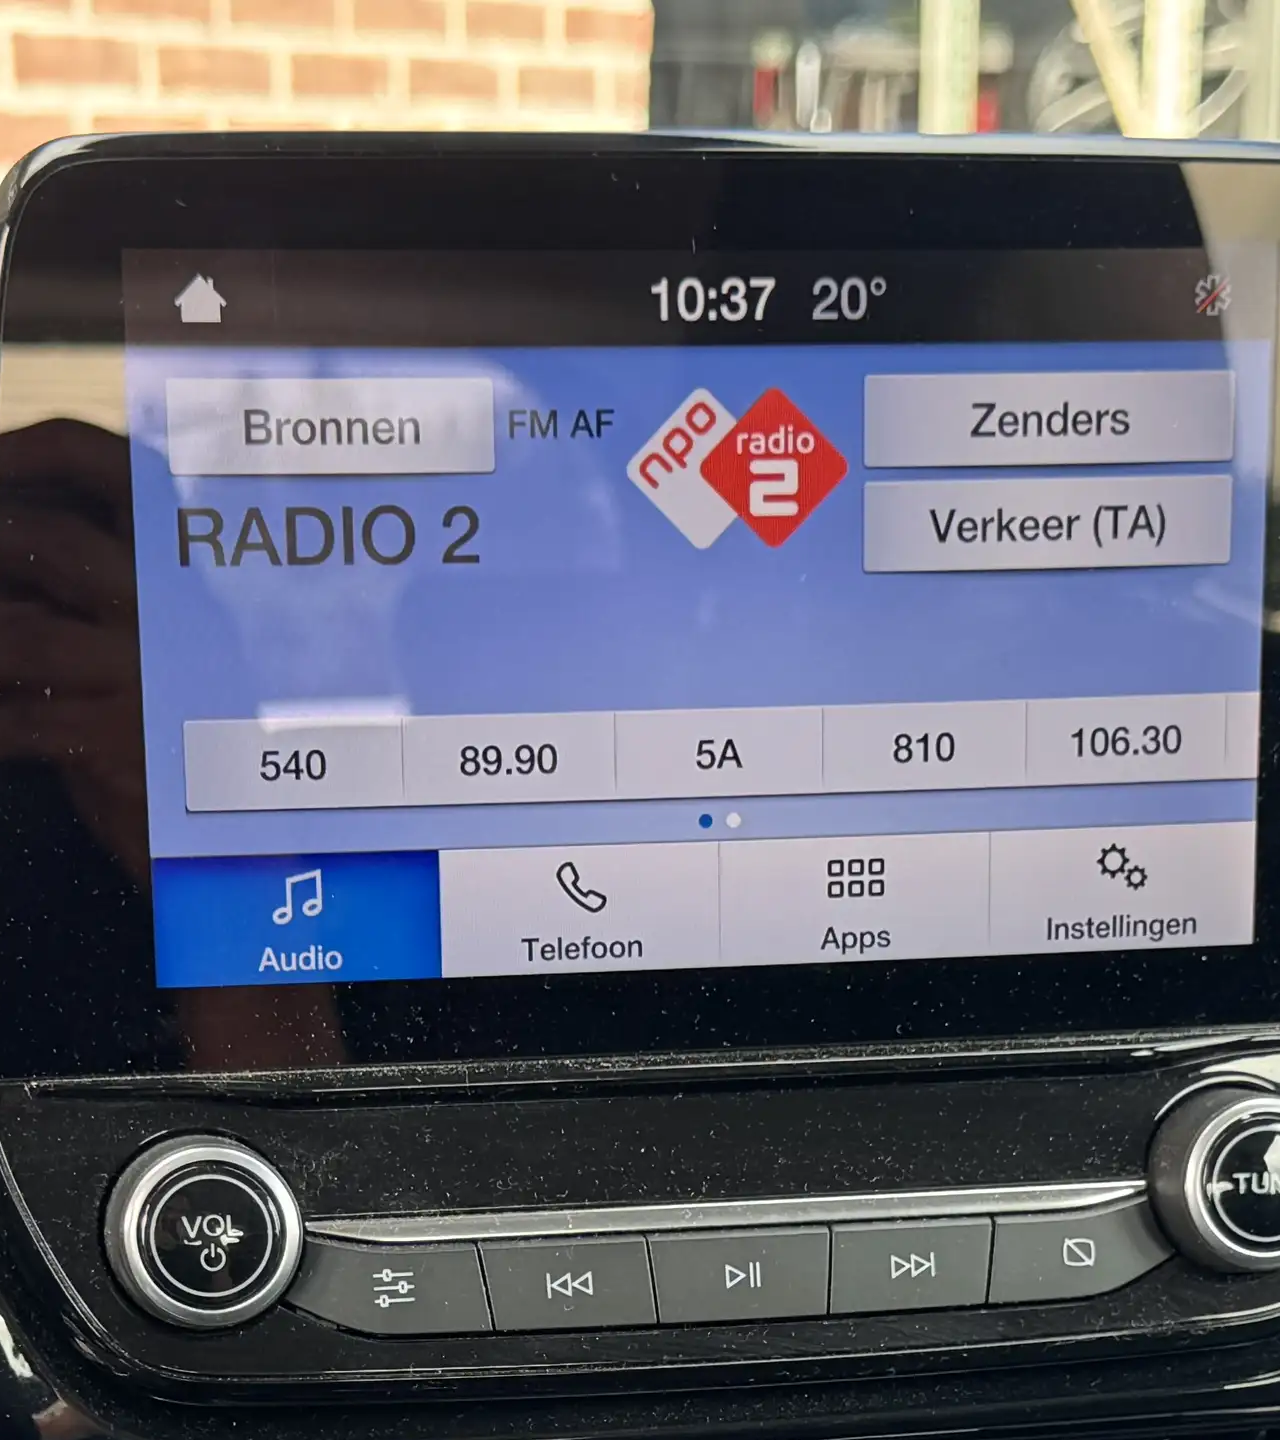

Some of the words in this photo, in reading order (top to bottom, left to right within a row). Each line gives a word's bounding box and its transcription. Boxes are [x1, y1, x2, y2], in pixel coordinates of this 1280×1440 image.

[650, 276, 776, 323] 10:37
[811, 277, 888, 322] 20°
[243, 408, 421, 446] Bronnen
[508, 410, 557, 439] FM
[569, 409, 615, 439] AF
[969, 402, 1131, 438] Zenders
[637, 401, 719, 490] npo
[736, 424, 815, 456] radio
[748, 459, 800, 517] 2
[177, 505, 416, 567] RADIO
[441, 505, 481, 564] 2
[929, 508, 1080, 545] Verkeer
[1092, 503, 1168, 547] (TA)
[695, 738, 743, 770] 5A
[892, 732, 956, 764] 810
[1070, 725, 1183, 758] 106.30
[259, 749, 327, 782] 540
[459, 743, 559, 777] 89.90
[820, 925, 892, 956] Apps
[1046, 912, 1198, 943] Instellingen
[258, 945, 343, 973] Audio
[521, 936, 643, 963] Telefoon
[180, 1213, 245, 1239] VOL
